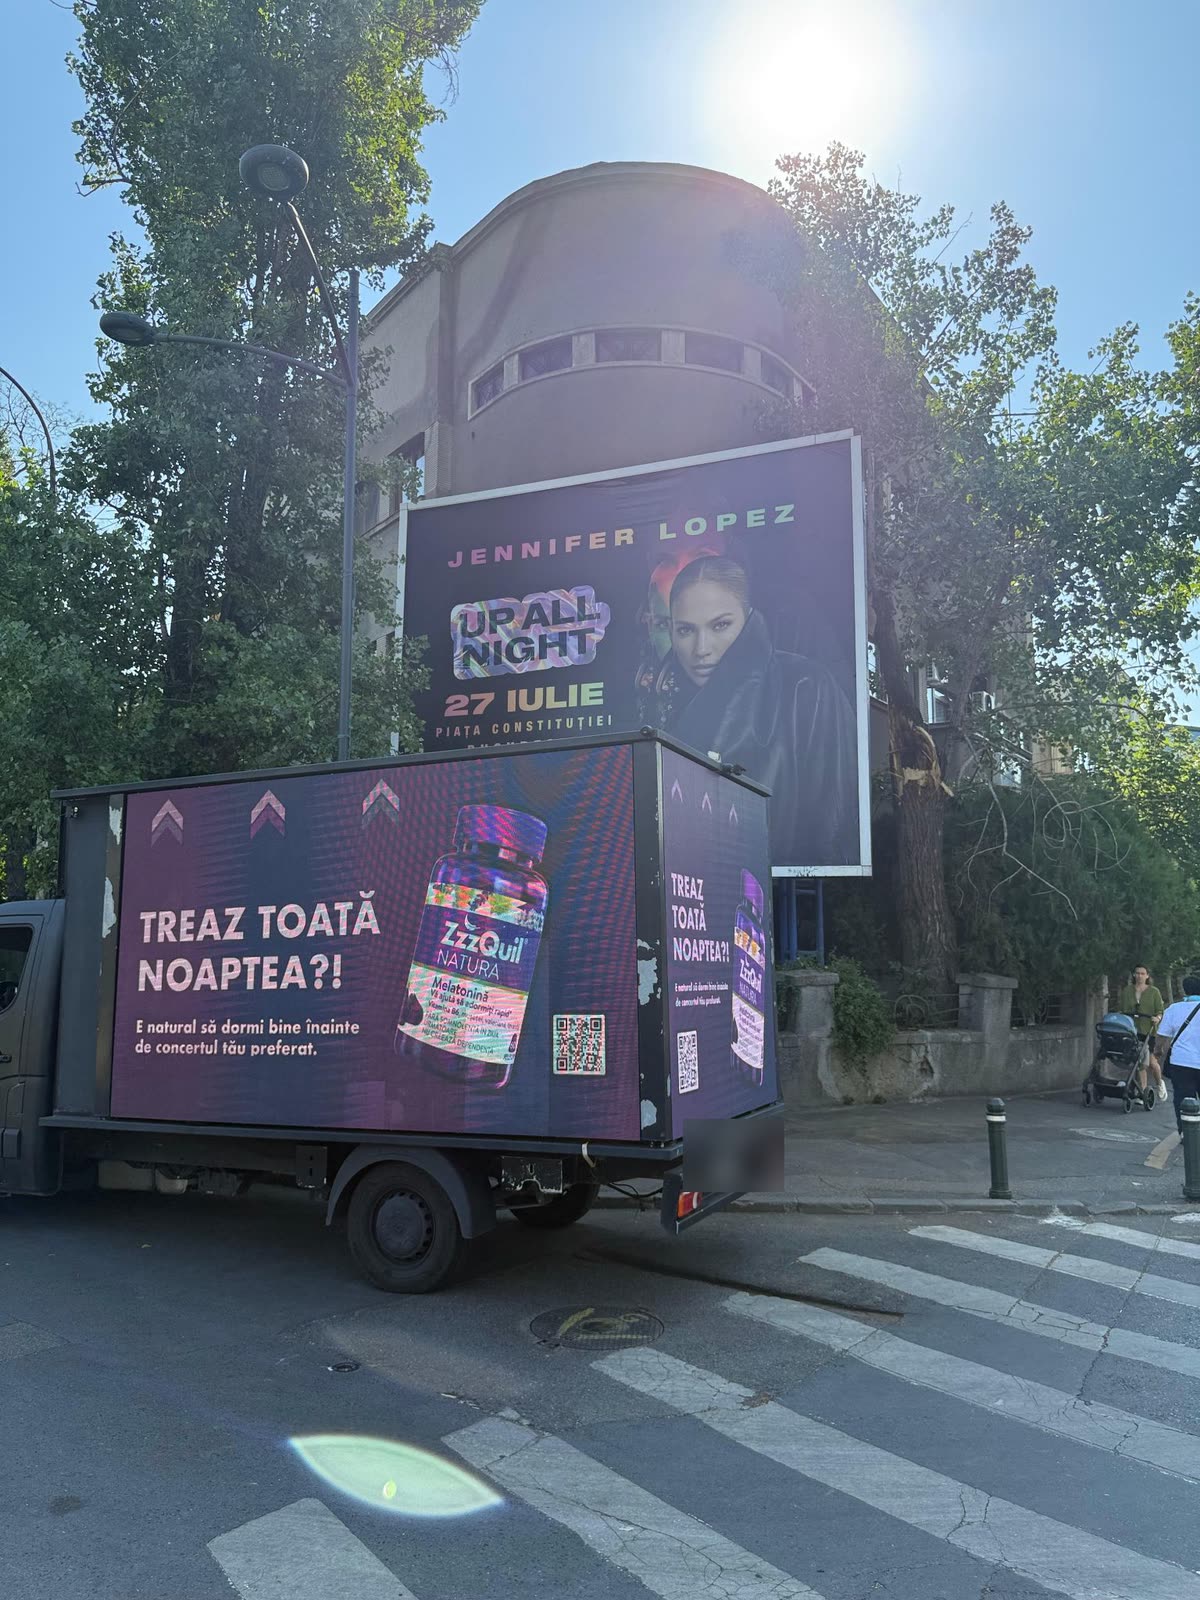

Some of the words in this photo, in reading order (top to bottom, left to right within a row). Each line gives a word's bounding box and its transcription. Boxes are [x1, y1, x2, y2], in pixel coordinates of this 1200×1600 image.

[447, 528, 634, 568] JENNIFER
[659, 504, 795, 541] LOPEZ
[460, 607, 515, 638] UP
[521, 595, 600, 630] ALL
[462, 628, 595, 666] NIGHT
[444, 692, 495, 717] 27
[507, 682, 604, 713] IULIE
[435, 725, 481, 738] PIAȚA
[492, 715, 612, 734] CONSTITUȚIEI
[671, 872, 704, 901] TREAZ
[140, 907, 246, 943] TREAZ
[258, 890, 381, 939] TOATĂ
[671, 903, 706, 931] TOATĂ
[437, 949, 499, 980] NATURA
[673, 937, 730, 963] NOAPTEA?!
[138, 954, 342, 991] NOAPTEA?!
[432, 976, 489, 1002] Melatonină
[136, 1020, 143, 1033] E
[147, 1020, 196, 1034] natural
[201, 1020, 217, 1035] să
[221, 1019, 264, 1035] dormi
[269, 1019, 301, 1035] bine
[305, 1020, 360, 1035] înainte
[135, 1039, 151, 1053] de
[155, 1040, 218, 1055] concertul
[222, 1040, 246, 1055] tău
[250, 1040, 317, 1057] preferat.
